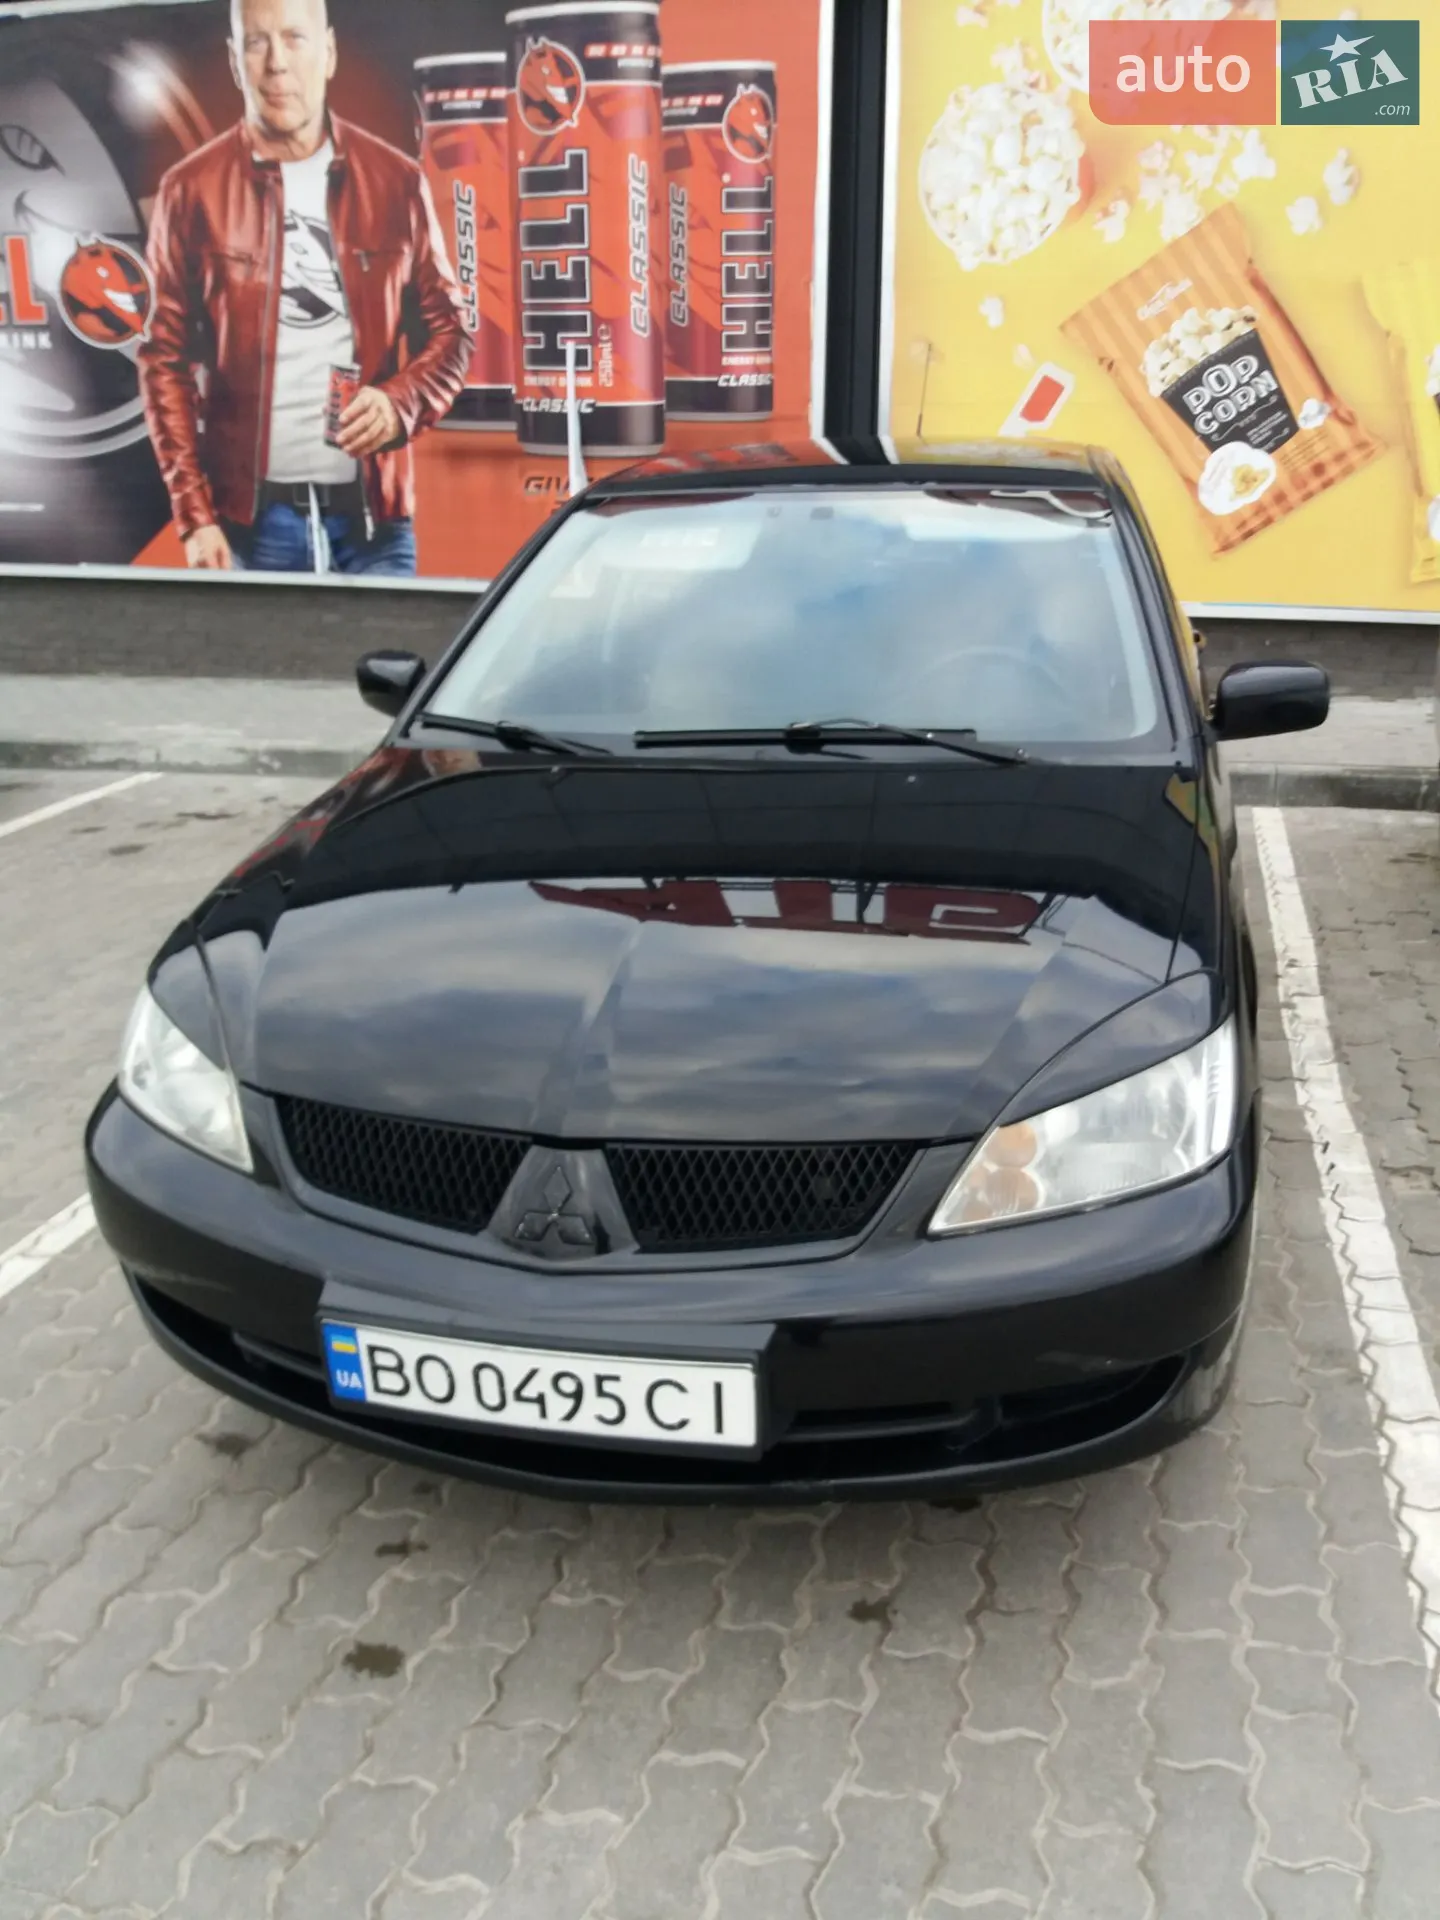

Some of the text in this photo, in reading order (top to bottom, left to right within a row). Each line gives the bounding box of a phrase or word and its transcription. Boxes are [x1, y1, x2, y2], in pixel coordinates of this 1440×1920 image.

[0, 235, 48, 325] L
[518, 148, 593, 371] HELL
[628, 152, 651, 338] CLASSIC
[669, 182, 688, 327] CLASSIC
[721, 175, 773, 353] HELL
[1182, 355, 1259, 415] POP
[1194, 370, 1278, 435] CORN
[335, 1368, 363, 1389] UA
[365, 1344, 456, 1405] BO
[471, 1361, 627, 1428] 0495
